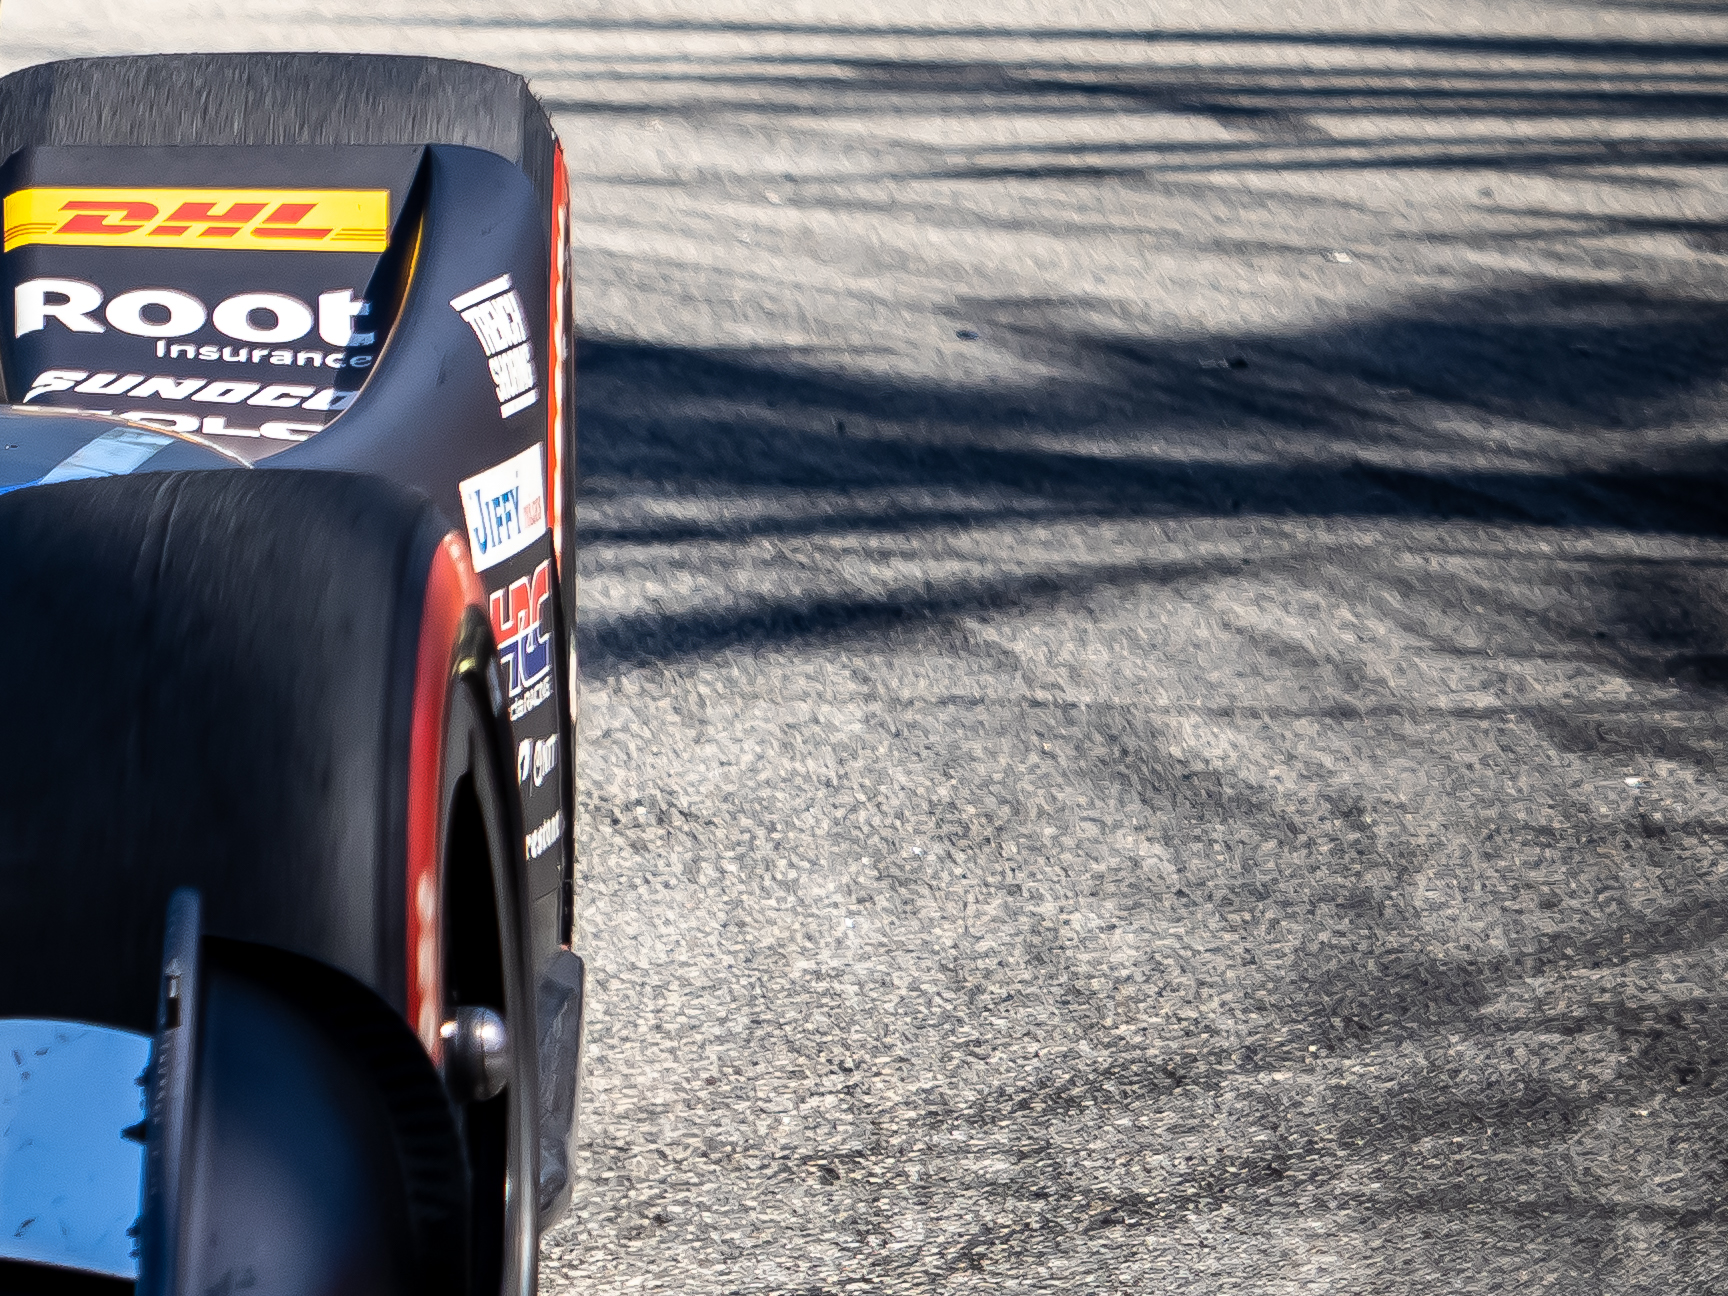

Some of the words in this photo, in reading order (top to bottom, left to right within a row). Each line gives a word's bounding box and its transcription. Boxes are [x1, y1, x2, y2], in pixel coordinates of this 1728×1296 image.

[53, 201, 334, 239] DHL
[15, 277, 376, 347] Root
[155, 338, 373, 370] Insurance
[473, 486, 521, 555] JIFFY
